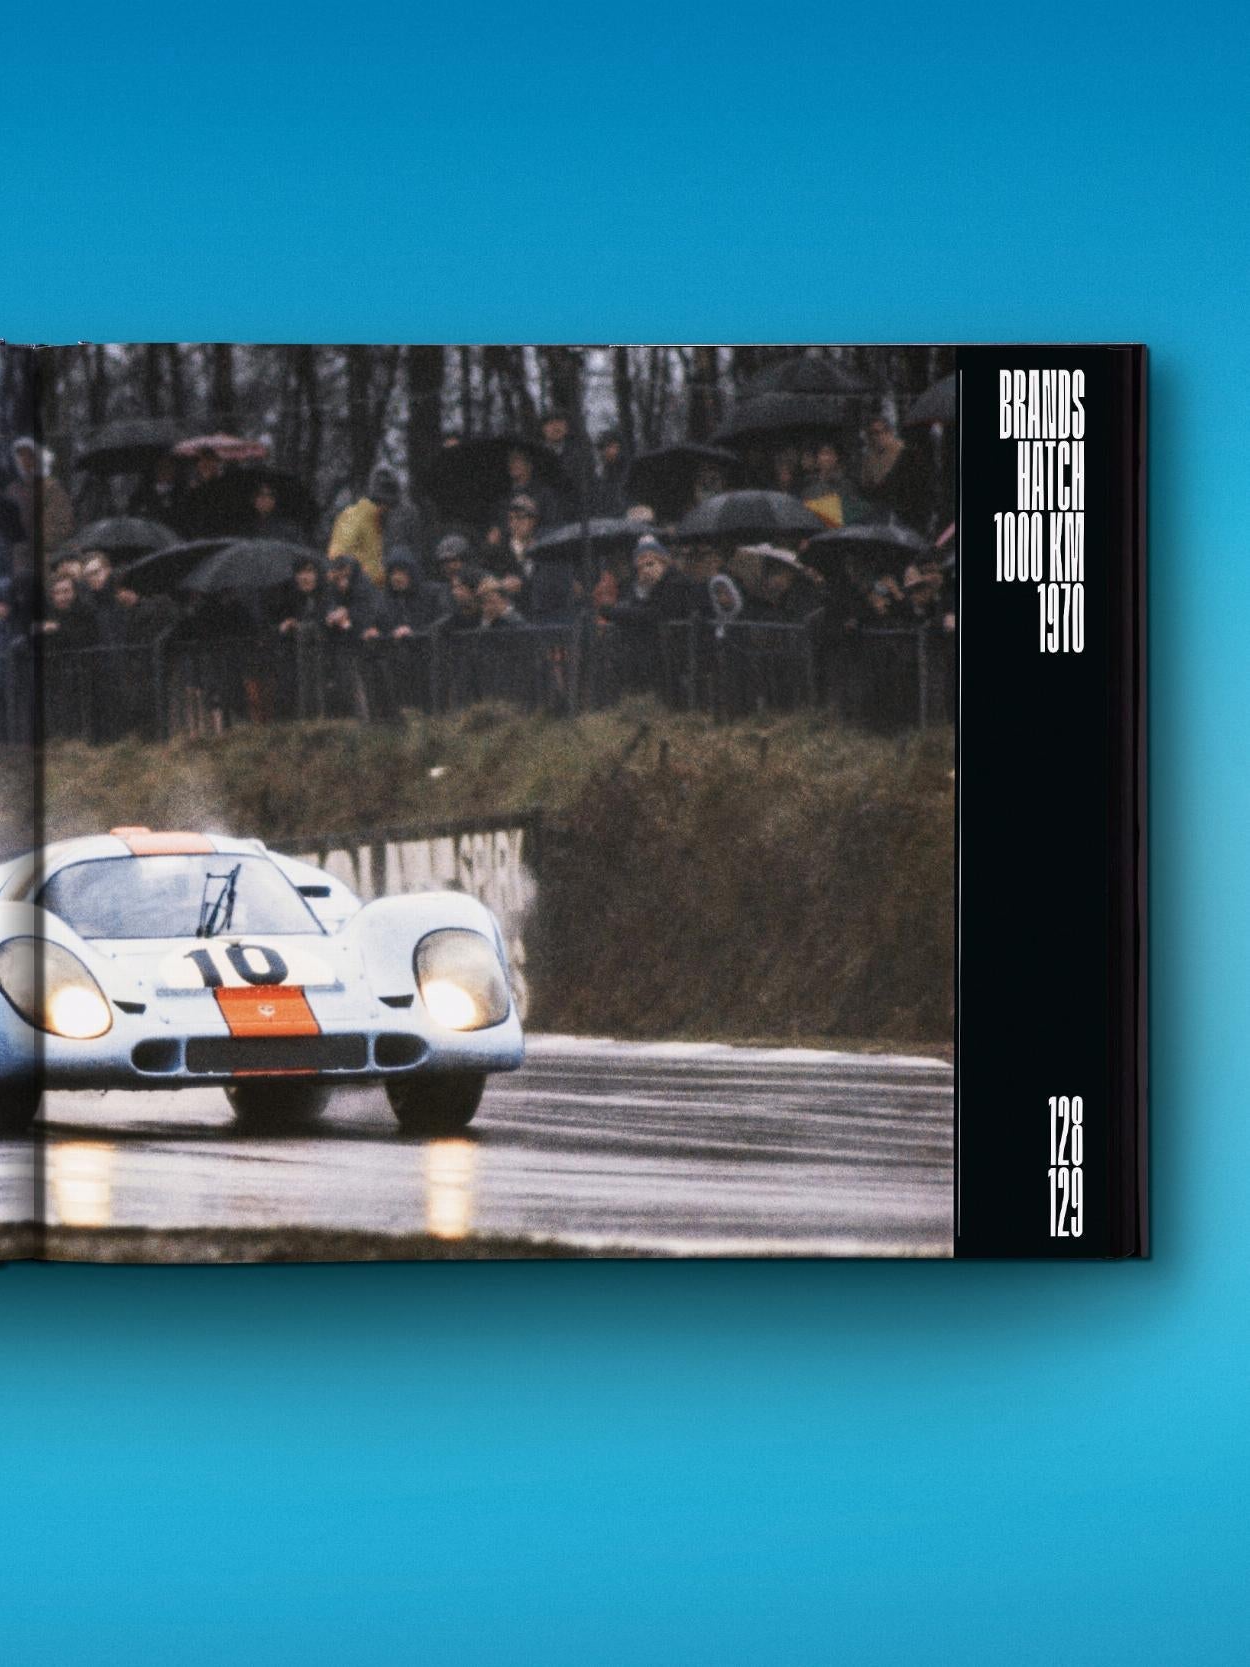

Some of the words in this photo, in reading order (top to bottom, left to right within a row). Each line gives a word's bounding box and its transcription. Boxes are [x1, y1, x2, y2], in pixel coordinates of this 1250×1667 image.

[1000, 369, 1085, 439] BRANDS
[1017, 441, 1085, 511] HATCH
[994, 512, 1043, 582] 1000
[1050, 512, 1085, 582] KM
[1037, 583, 1085, 653] 1970
[183, 944, 289, 988] 10
[1048, 1096, 1083, 1166] 128
[1048, 1167, 1083, 1237] 129
